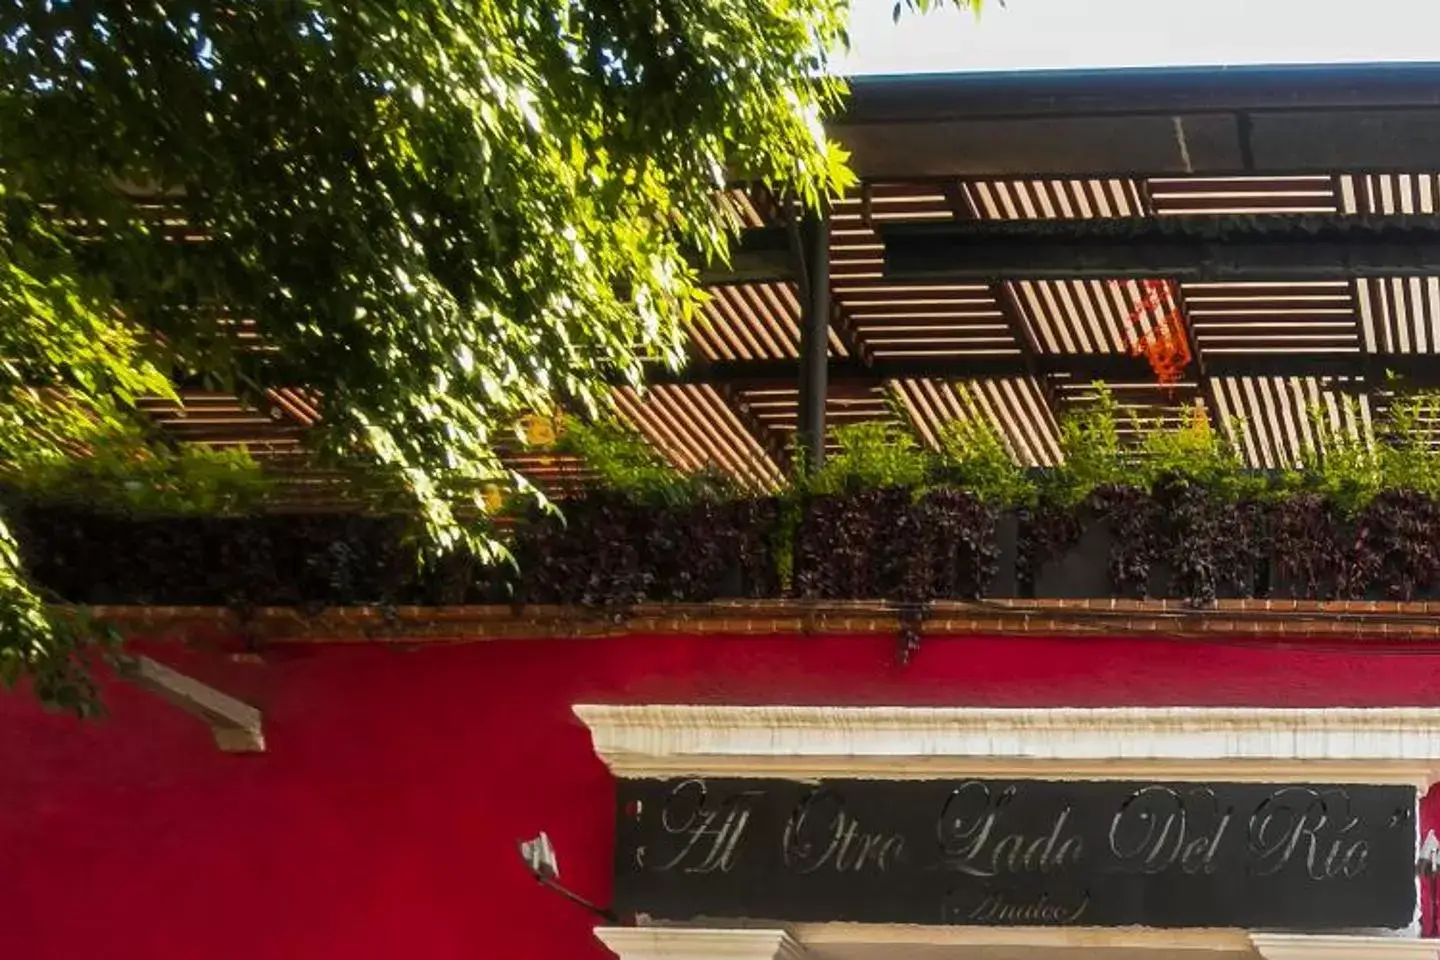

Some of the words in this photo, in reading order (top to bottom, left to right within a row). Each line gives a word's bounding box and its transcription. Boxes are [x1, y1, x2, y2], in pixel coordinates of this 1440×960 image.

[778, 786, 909, 875] Otro
[923, 780, 1084, 878] Lado
[1103, 783, 1237, 876] Del
